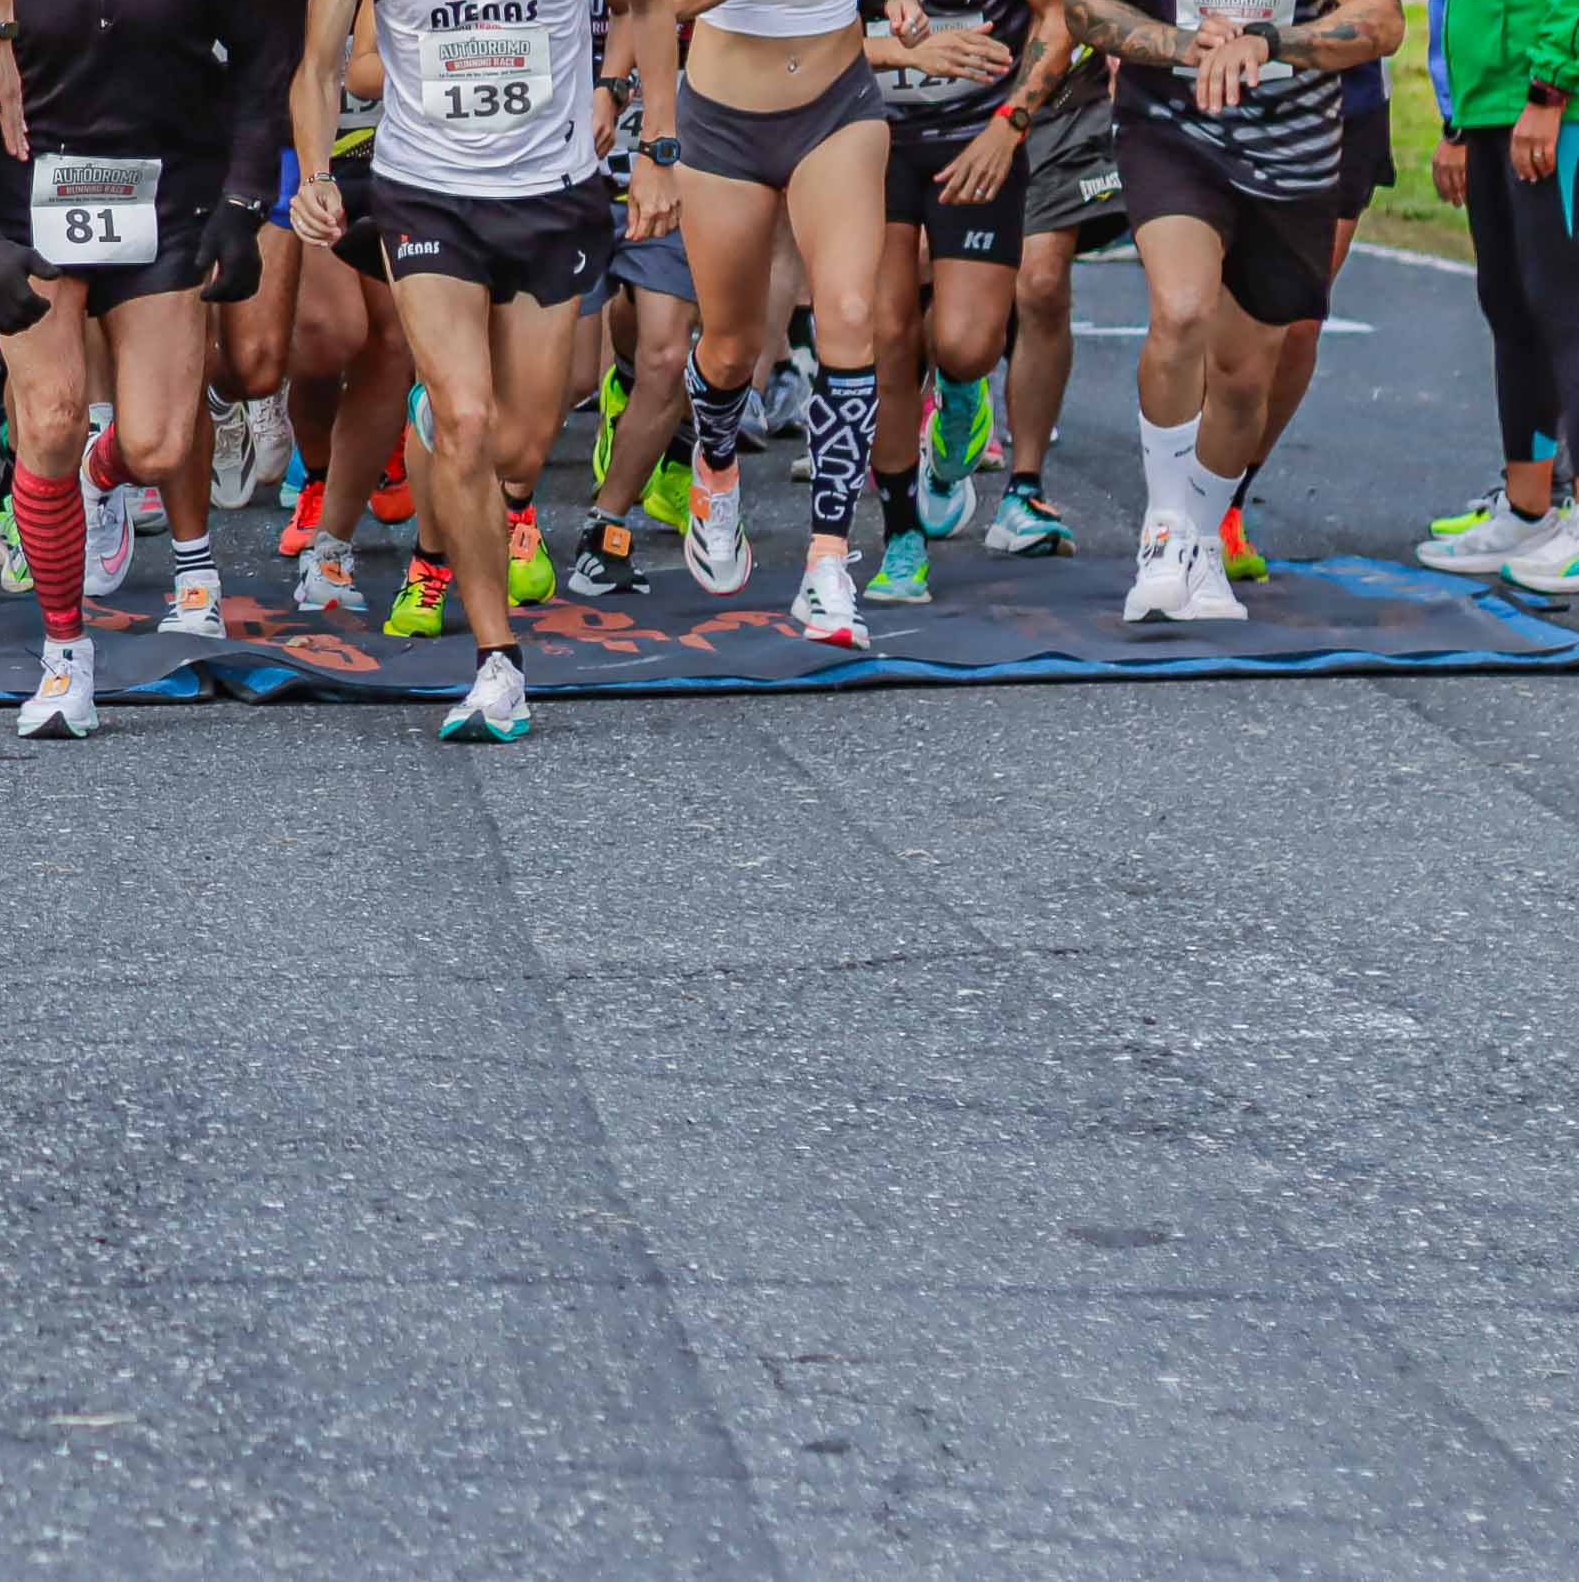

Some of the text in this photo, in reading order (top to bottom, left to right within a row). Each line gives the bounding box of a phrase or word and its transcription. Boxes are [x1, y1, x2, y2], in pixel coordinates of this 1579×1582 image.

[430, 0, 539, 29] ATENAS
[439, 37, 531, 60] AUTÓDROMO
[443, 81, 532, 120] 138
[52, 163, 140, 185] AUTÓDROMO
[65, 208, 122, 244] 81
[964, 231, 995, 250] K1
